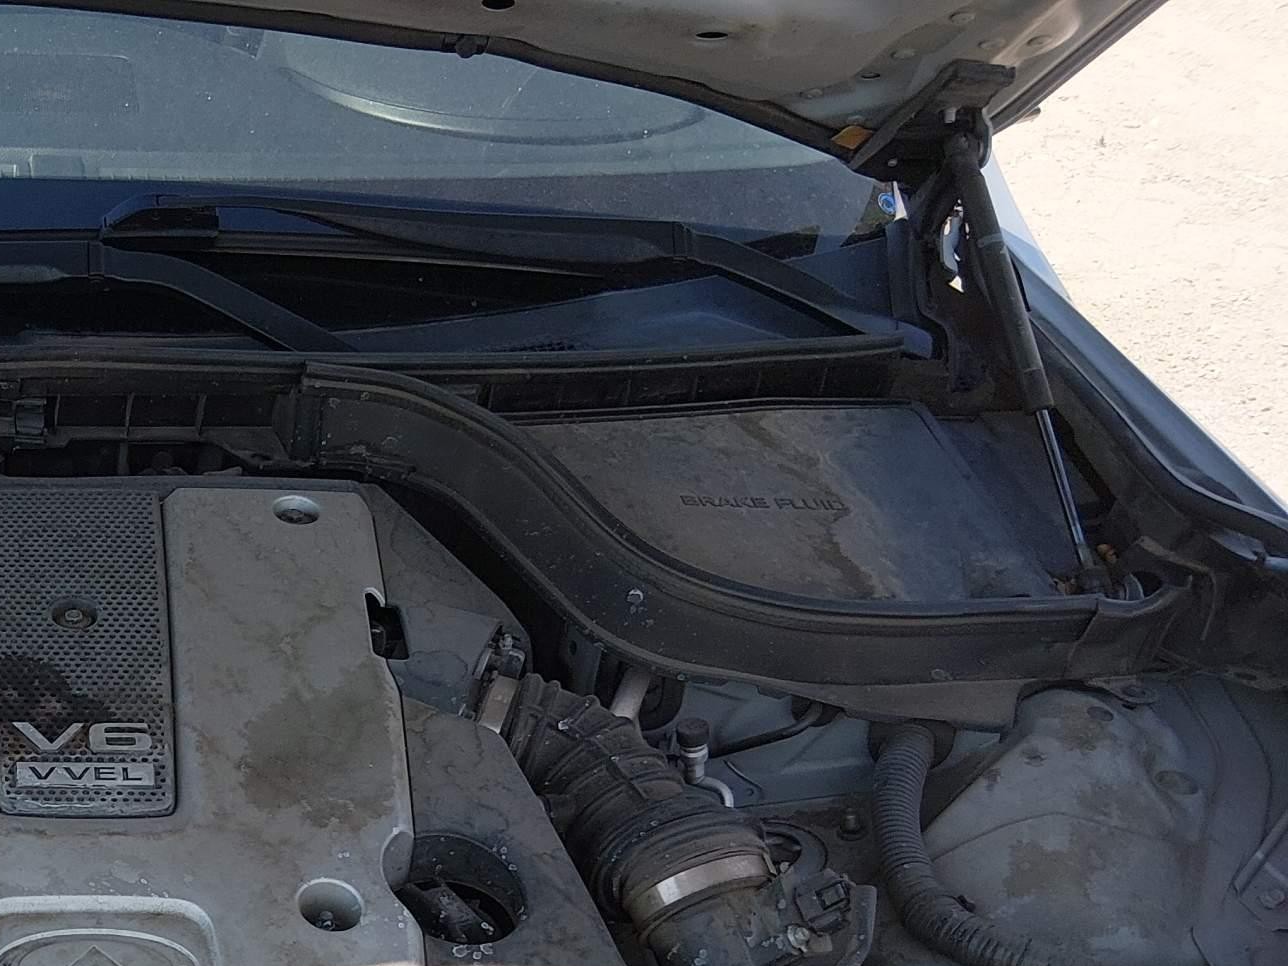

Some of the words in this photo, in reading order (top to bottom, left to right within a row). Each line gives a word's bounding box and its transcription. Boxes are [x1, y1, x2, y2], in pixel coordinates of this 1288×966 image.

[680, 495, 770, 509] BRAKE
[774, 498, 849, 511] FLUID
[13, 721, 152, 751] V6
[28, 766, 143, 781] VVEL
